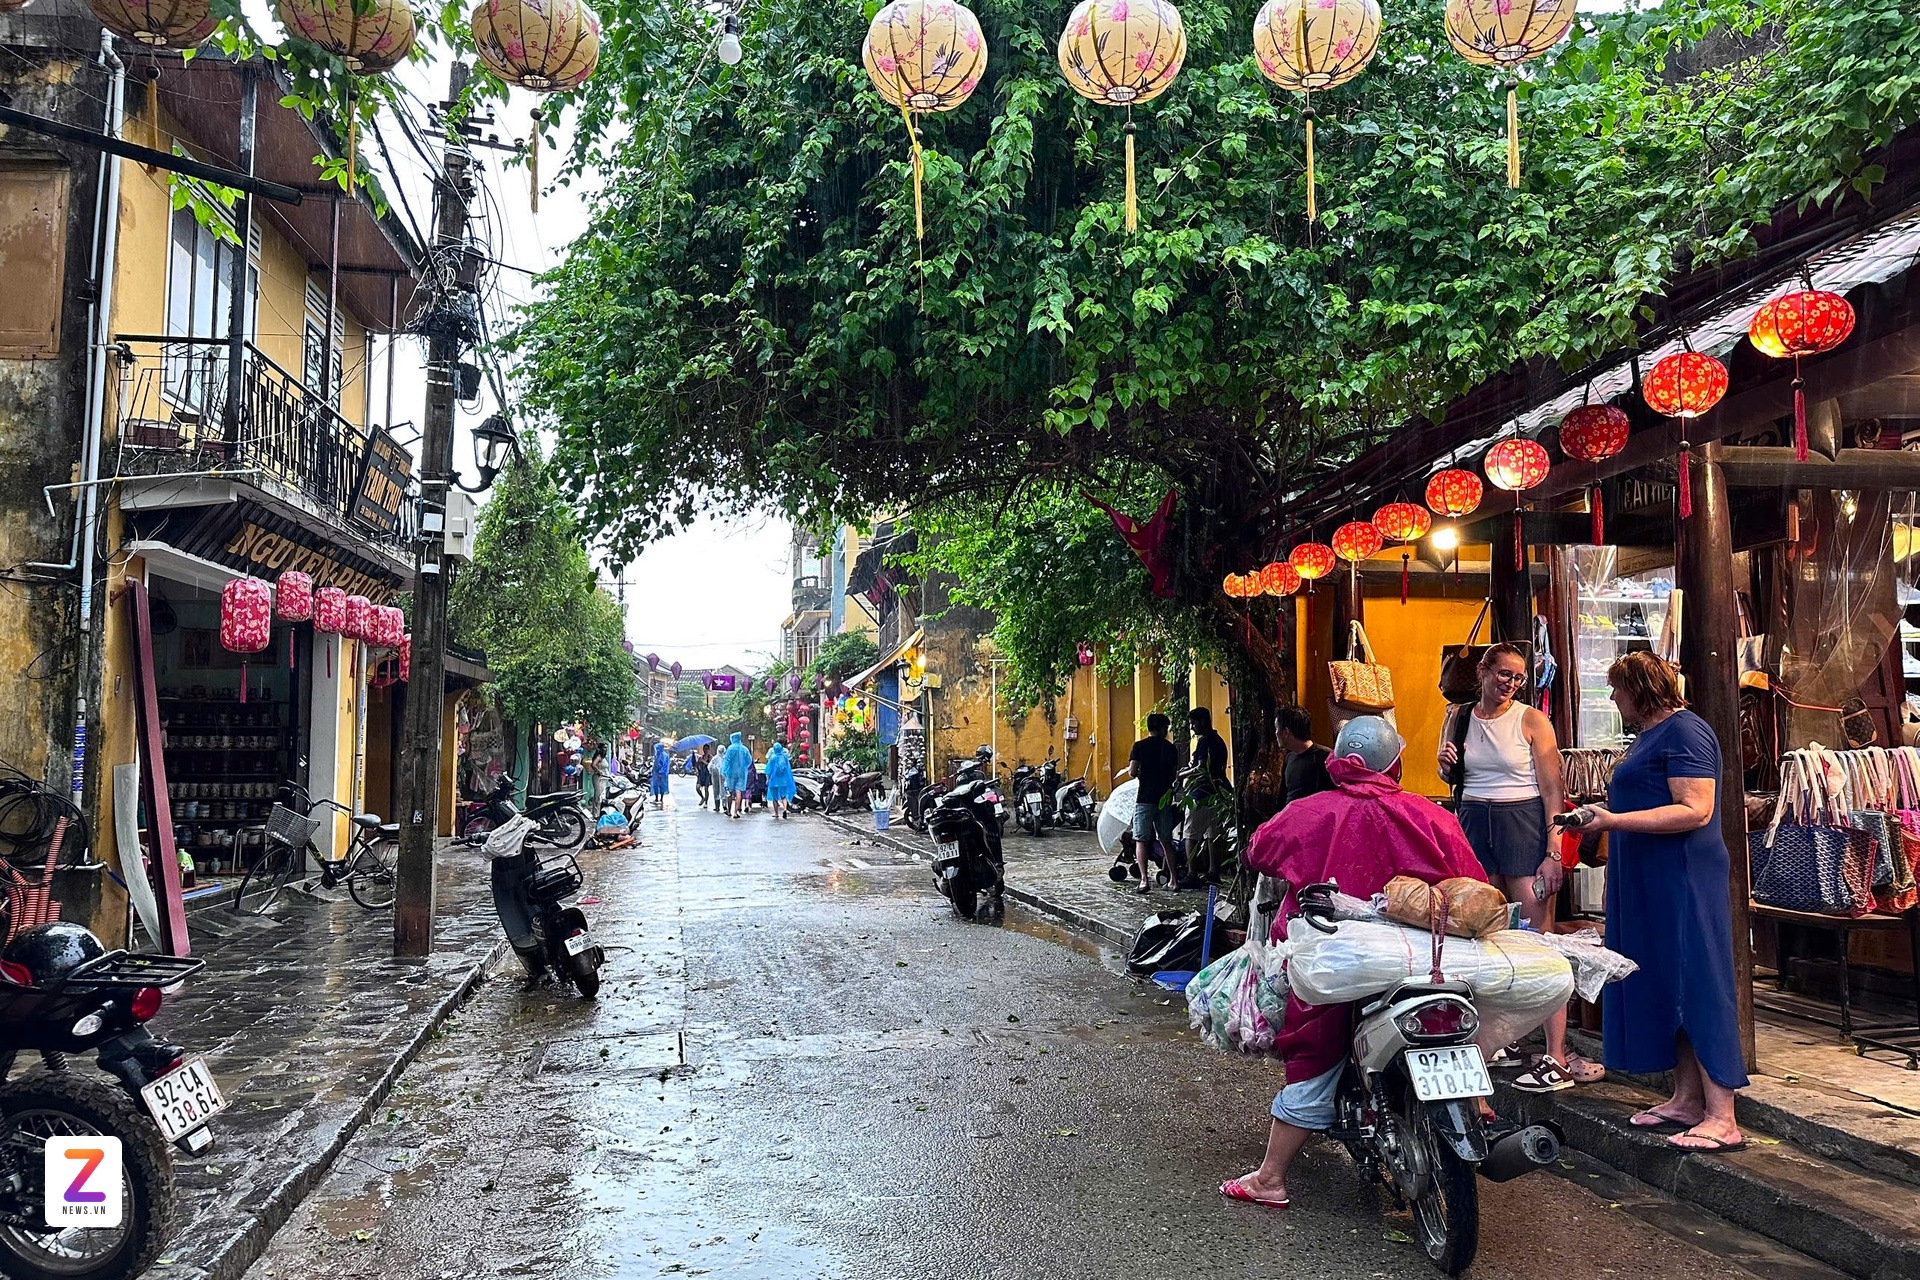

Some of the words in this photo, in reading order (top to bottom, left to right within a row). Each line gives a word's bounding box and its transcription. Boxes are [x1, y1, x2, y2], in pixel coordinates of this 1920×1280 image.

[1418, 1049, 1474, 1073] 92-AA
[154, 1066, 203, 1108] 92-CA
[1418, 1071, 1488, 1096] 318.42
[161, 1086, 220, 1135] 138.64
